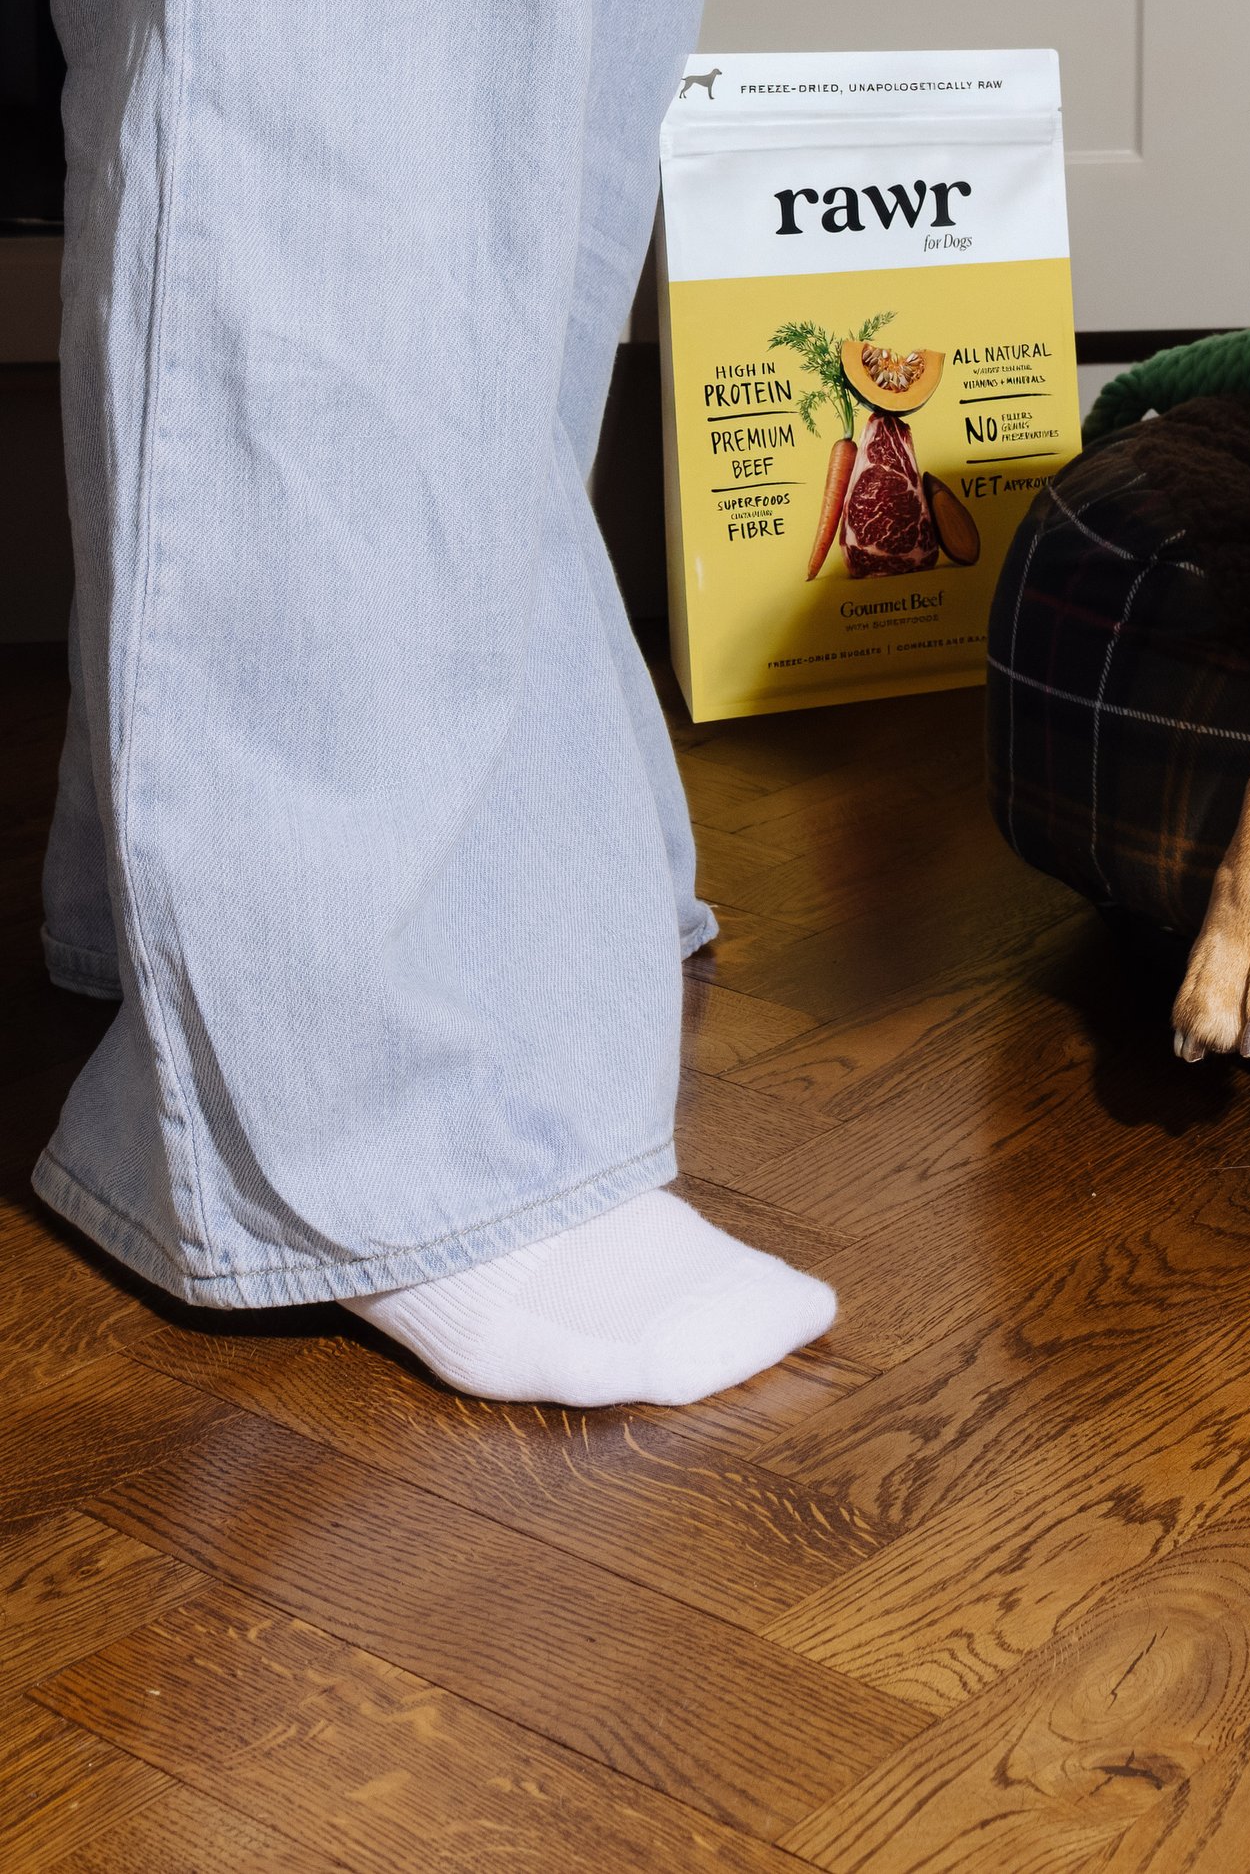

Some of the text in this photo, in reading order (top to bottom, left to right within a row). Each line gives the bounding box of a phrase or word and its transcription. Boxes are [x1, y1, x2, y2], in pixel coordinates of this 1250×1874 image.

[741, 80, 1003, 95] FREEZE-DRIED, UNAPOLOGETICALLY RAW
[774, 179, 972, 235] rawr
[924, 233, 973, 252] for Dogs
[952, 342, 1053, 365] ALL NATURAL
[715, 362, 776, 379] HIGH IN
[1006, 375, 1046, 385] MINERALS
[704, 380, 793, 407] PROTEIN
[711, 424, 796, 455] PREMIUM
[964, 415, 998, 445] NO
[731, 457, 774, 479] BEEF
[960, 474, 1003, 498] VET
[717, 493, 791, 511] SUPERFOODS
[727, 518, 786, 542] FIBRE
[840, 590, 945, 618] Gourmet Beef
